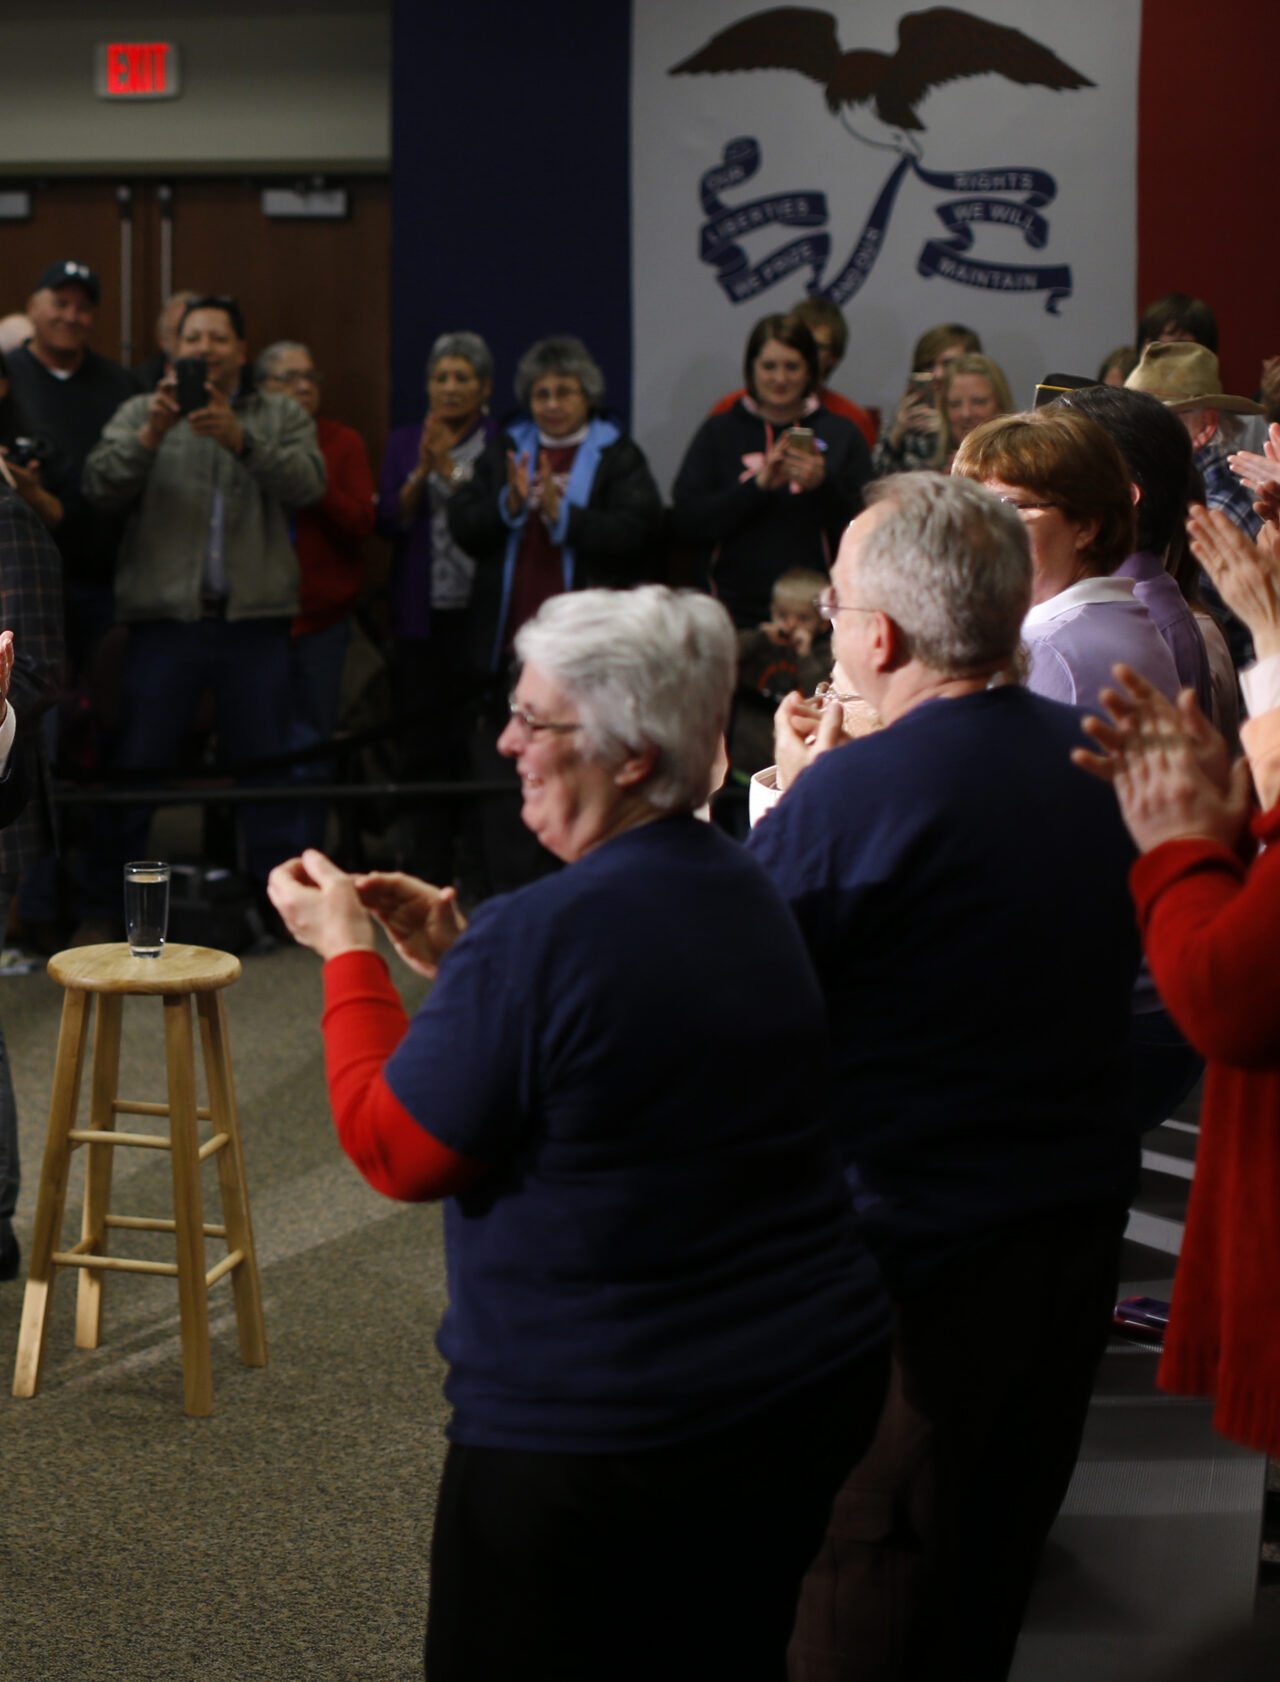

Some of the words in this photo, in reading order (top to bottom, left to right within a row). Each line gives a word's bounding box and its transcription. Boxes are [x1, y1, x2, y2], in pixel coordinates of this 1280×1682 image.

[107, 43, 169, 93] EXIT
[954, 172, 1035, 191] RIGHTS
[706, 198, 810, 245] LIBERTIES
[952, 201, 986, 222] WE
[989, 204, 1036, 231] WILL
[854, 226, 881, 268] OUR
[733, 273, 762, 297] WE
[760, 243, 813, 280] PRIZE
[939, 256, 1038, 290] MAINTAIN
